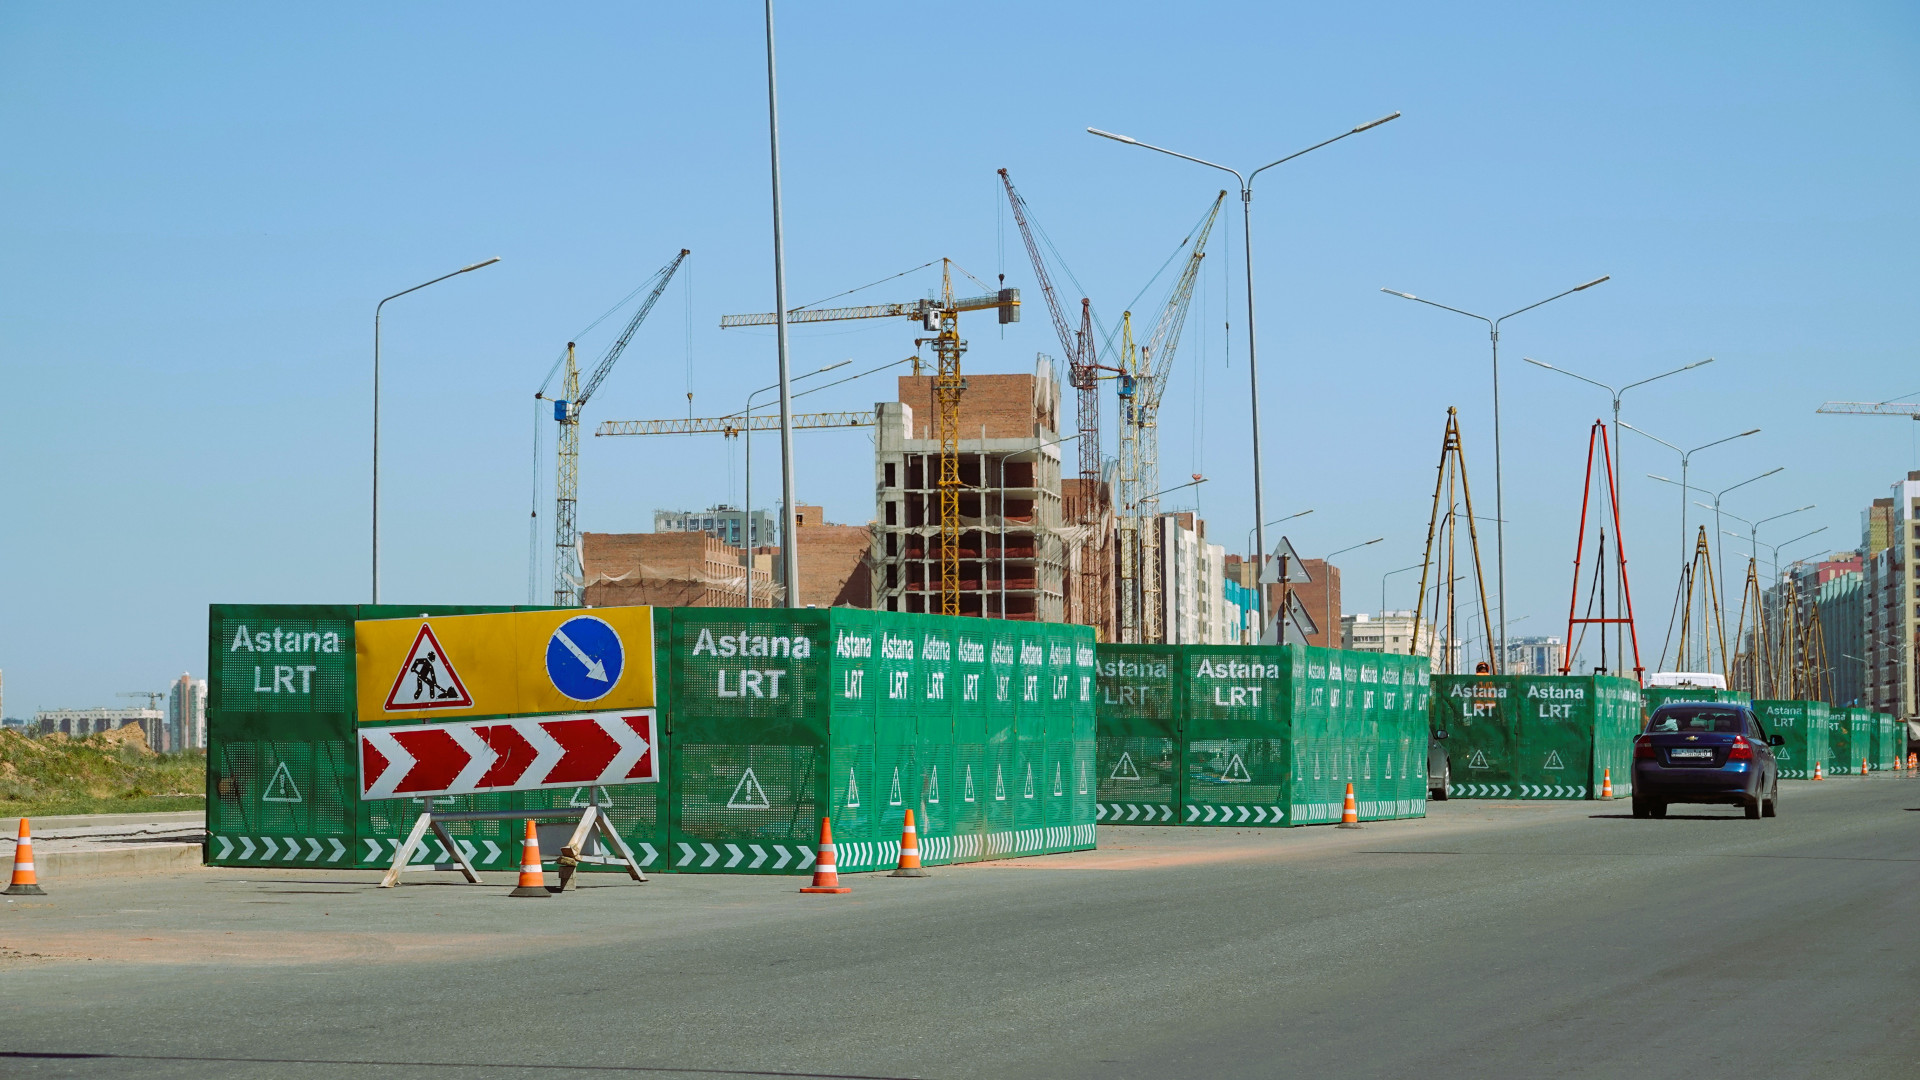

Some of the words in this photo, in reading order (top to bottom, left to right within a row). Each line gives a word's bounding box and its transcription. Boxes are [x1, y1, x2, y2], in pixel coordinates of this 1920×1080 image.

[230, 625, 340, 653] Astana
[692, 628, 811, 659] Astana
[836, 629, 872, 659] Astana
[881, 631, 914, 660] Astana
[922, 633, 950, 660] Astana
[958, 636, 984, 663] Astana
[991, 639, 1014, 665] Astana
[1020, 639, 1042, 665] Astana
[1049, 640, 1071, 665] Astana
[1076, 642, 1093, 667] Astana
[254, 665, 317, 693] LRT
[1196, 658, 1279, 679] Astana
[717, 669, 786, 699] LRT
[844, 669, 864, 699] LRT
[889, 671, 908, 699] LRT
[927, 672, 944, 700] LRT
[963, 674, 979, 702] LRT
[996, 675, 1010, 700] LRT
[1024, 675, 1037, 702] LRT
[1053, 675, 1068, 699] LRT
[1080, 677, 1090, 701] LRT
[1105, 686, 1149, 705] LRT
[1215, 687, 1262, 706] LRT
[1450, 684, 1507, 698] Astana
[1527, 685, 1584, 699] Astana
[1311, 687, 1323, 707] LRT
[1363, 690, 1374, 708] LRT
[1383, 692, 1396, 710] LRT
[1463, 703, 1496, 717] LRT
[1539, 704, 1573, 718] LRT
[1766, 706, 1802, 715] Astana
[1774, 718, 1794, 727] LRT
